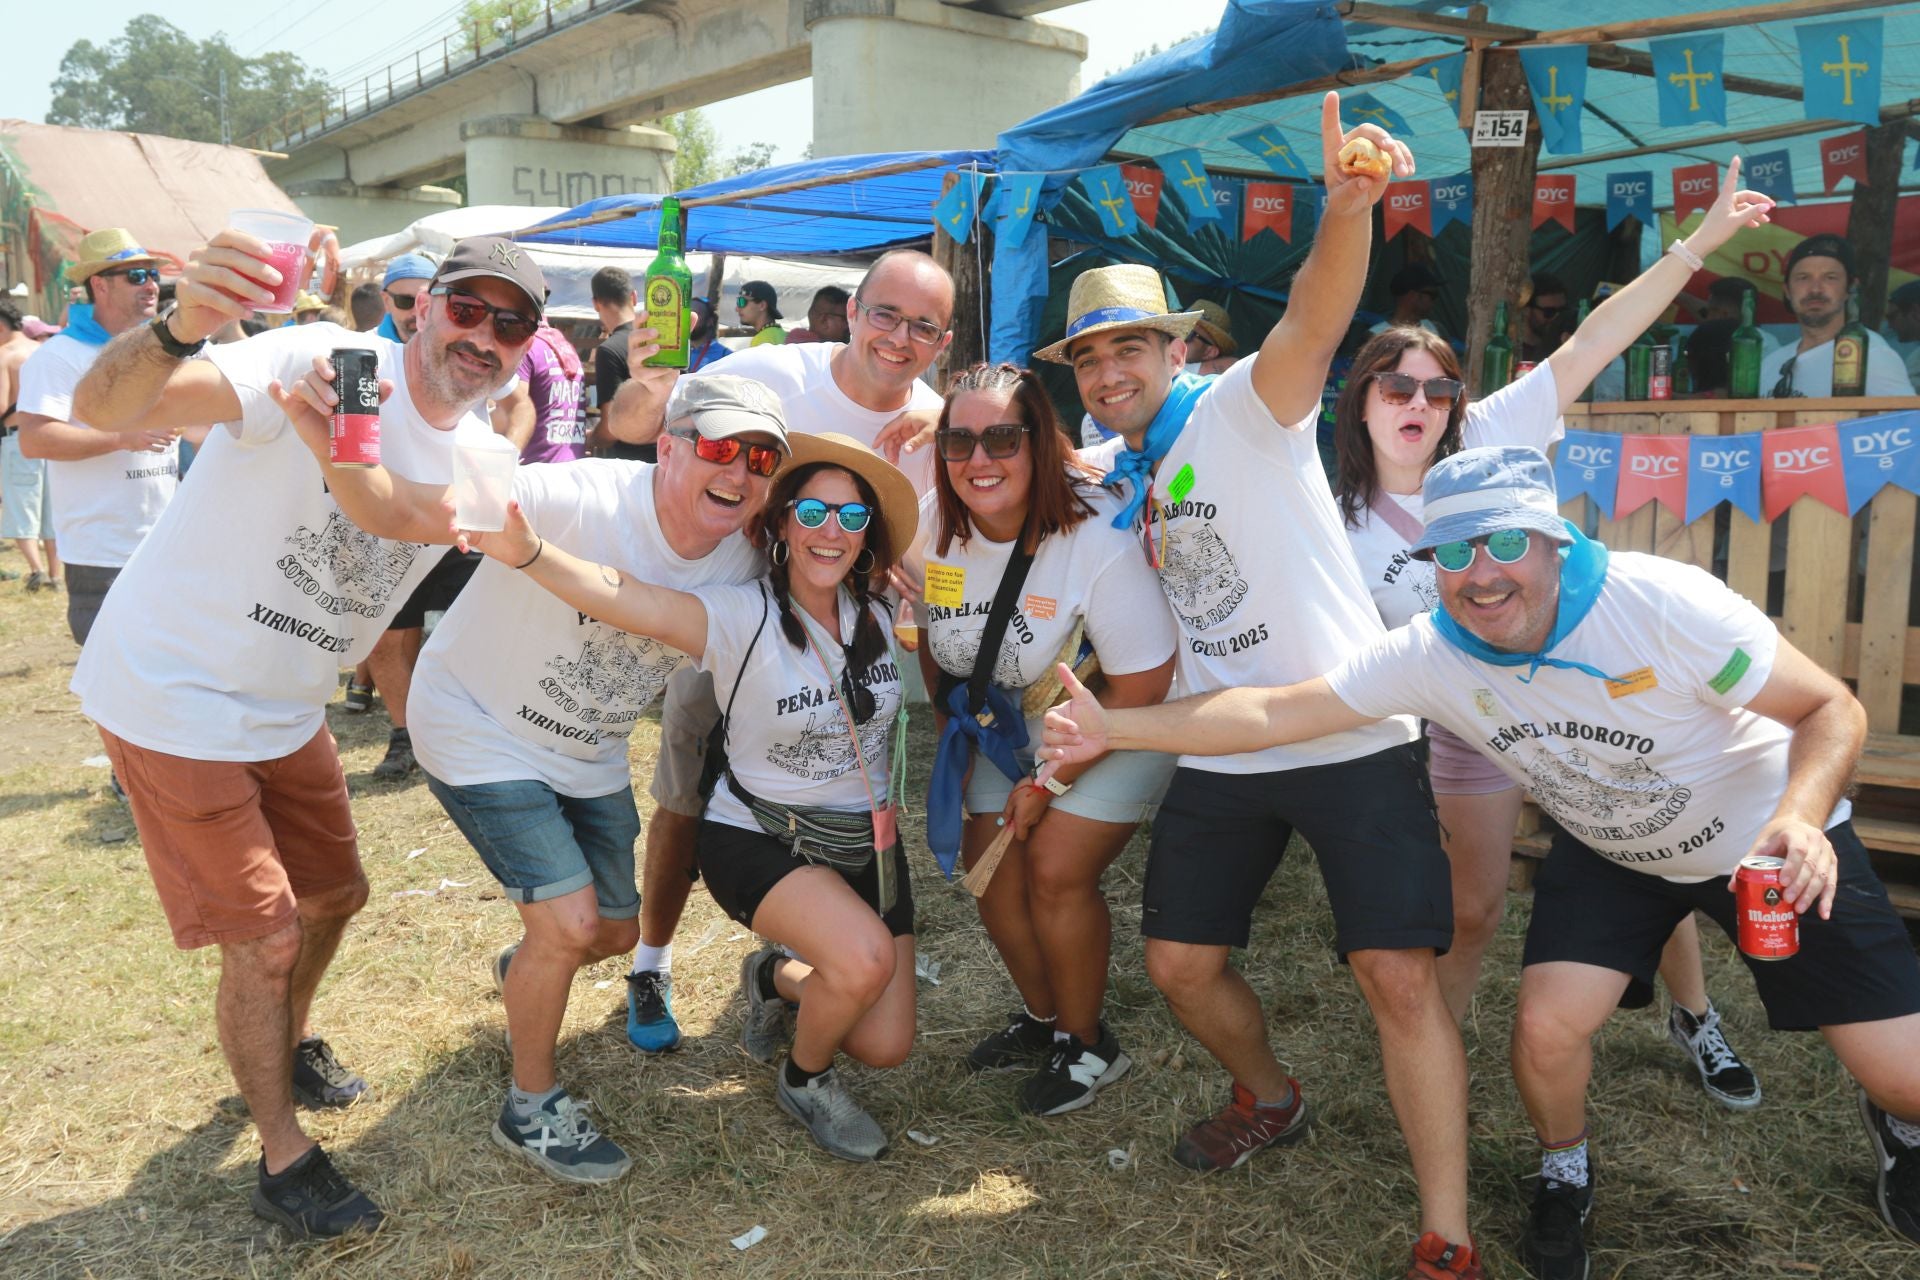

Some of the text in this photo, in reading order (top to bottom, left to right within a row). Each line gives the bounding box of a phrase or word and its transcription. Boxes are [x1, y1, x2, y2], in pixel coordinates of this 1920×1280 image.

[1491, 119, 1523, 137] 154
[1828, 144, 1860, 162] DYC
[1751, 161, 1784, 177] DYC
[1435, 184, 1467, 200] DYC
[1613, 181, 1646, 195] DYC
[1680, 177, 1712, 192] DYC
[1211, 189, 1232, 203] YC
[1390, 194, 1423, 208] DYC
[1536, 188, 1569, 201] DYC
[1253, 197, 1286, 211] DYC
[1743, 249, 1794, 275] DY
[1852, 428, 1912, 453] DYC
[1567, 444, 1613, 464] DYC
[1700, 450, 1750, 469] DYC
[1773, 446, 1830, 469] DYC
[1878, 456, 1894, 469] 8
[1631, 455, 1679, 473] DYC
[1582, 469, 1596, 480] 8
[1719, 475, 1734, 486] 8
[276, 554, 321, 596] SOTO
[1229, 623, 1269, 653] 2025
[538, 676, 579, 713] SOTO
[776, 685, 824, 716] PEÑA
[1547, 721, 1655, 755] ALBOROTO
[1590, 825, 1634, 841] DEL
[1630, 787, 1692, 838] BARCO
[1678, 816, 1725, 854] 2025
[1747, 909, 1795, 923] Mahou
